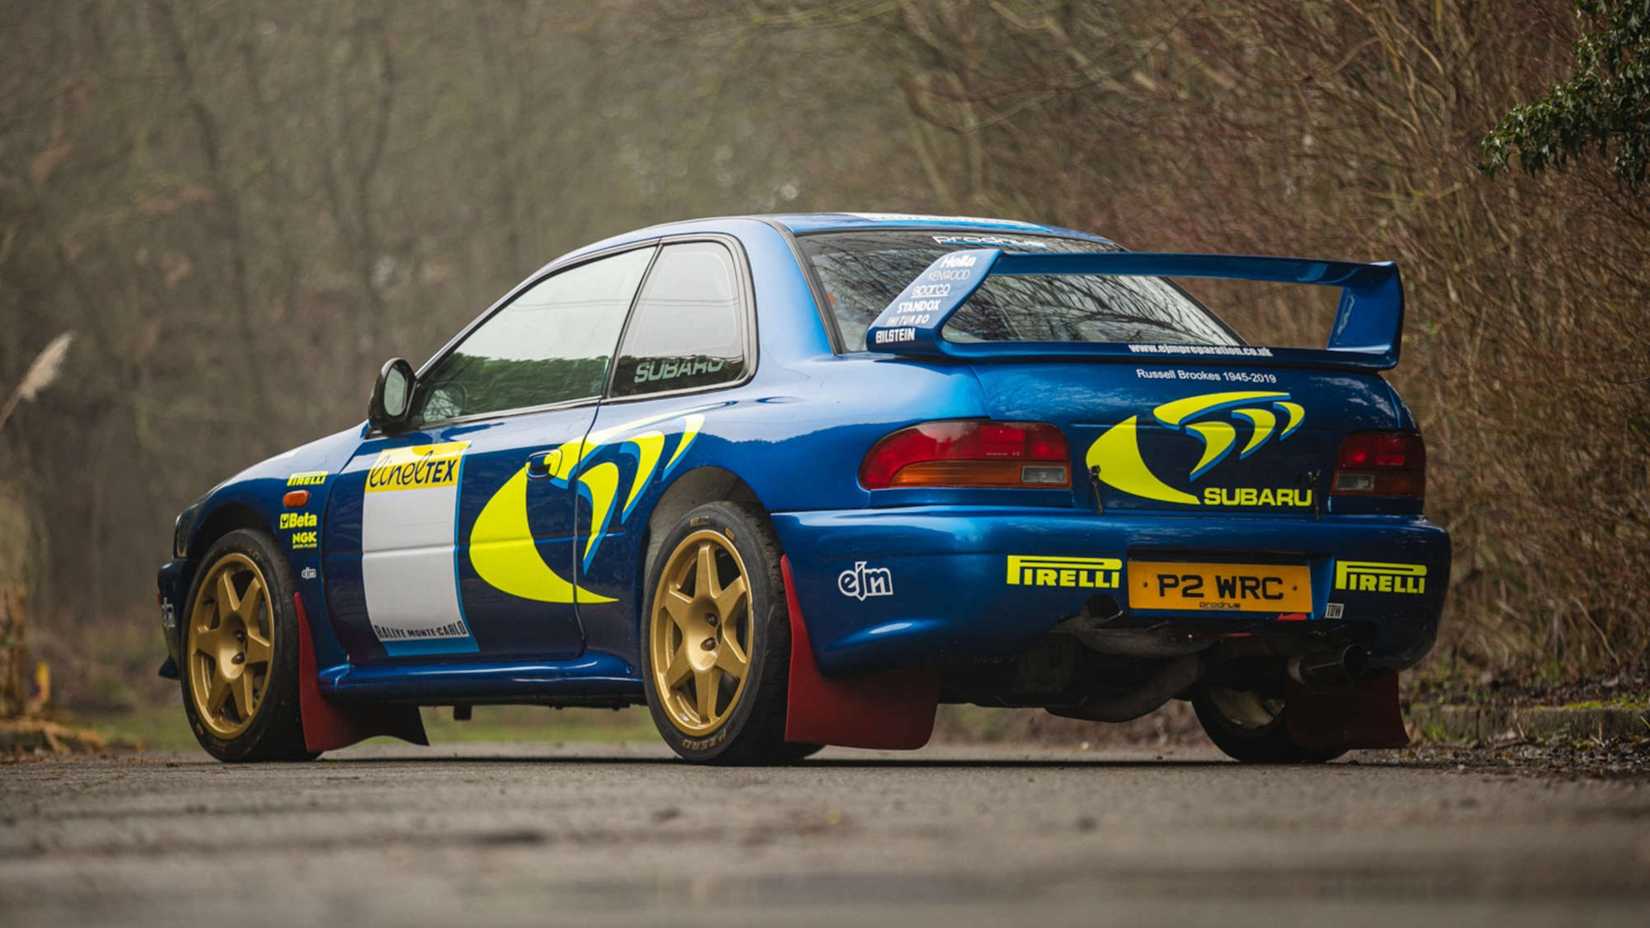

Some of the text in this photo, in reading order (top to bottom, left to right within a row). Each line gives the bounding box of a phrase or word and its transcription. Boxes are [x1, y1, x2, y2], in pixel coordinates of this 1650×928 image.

[897, 301, 941, 314] STANDOX
[875, 328, 916, 344] BILSTEIN
[1136, 368, 1277, 384] Russell Brookes 1945-2019
[1203, 487, 1313, 507] SUBARU
[289, 513, 318, 528] Beta
[292, 532, 317, 543] NGK
[1006, 554, 1123, 589] PIRELLI
[1335, 560, 1428, 594] PIRELLI
[1157, 574, 1285, 600] P2 WRC
